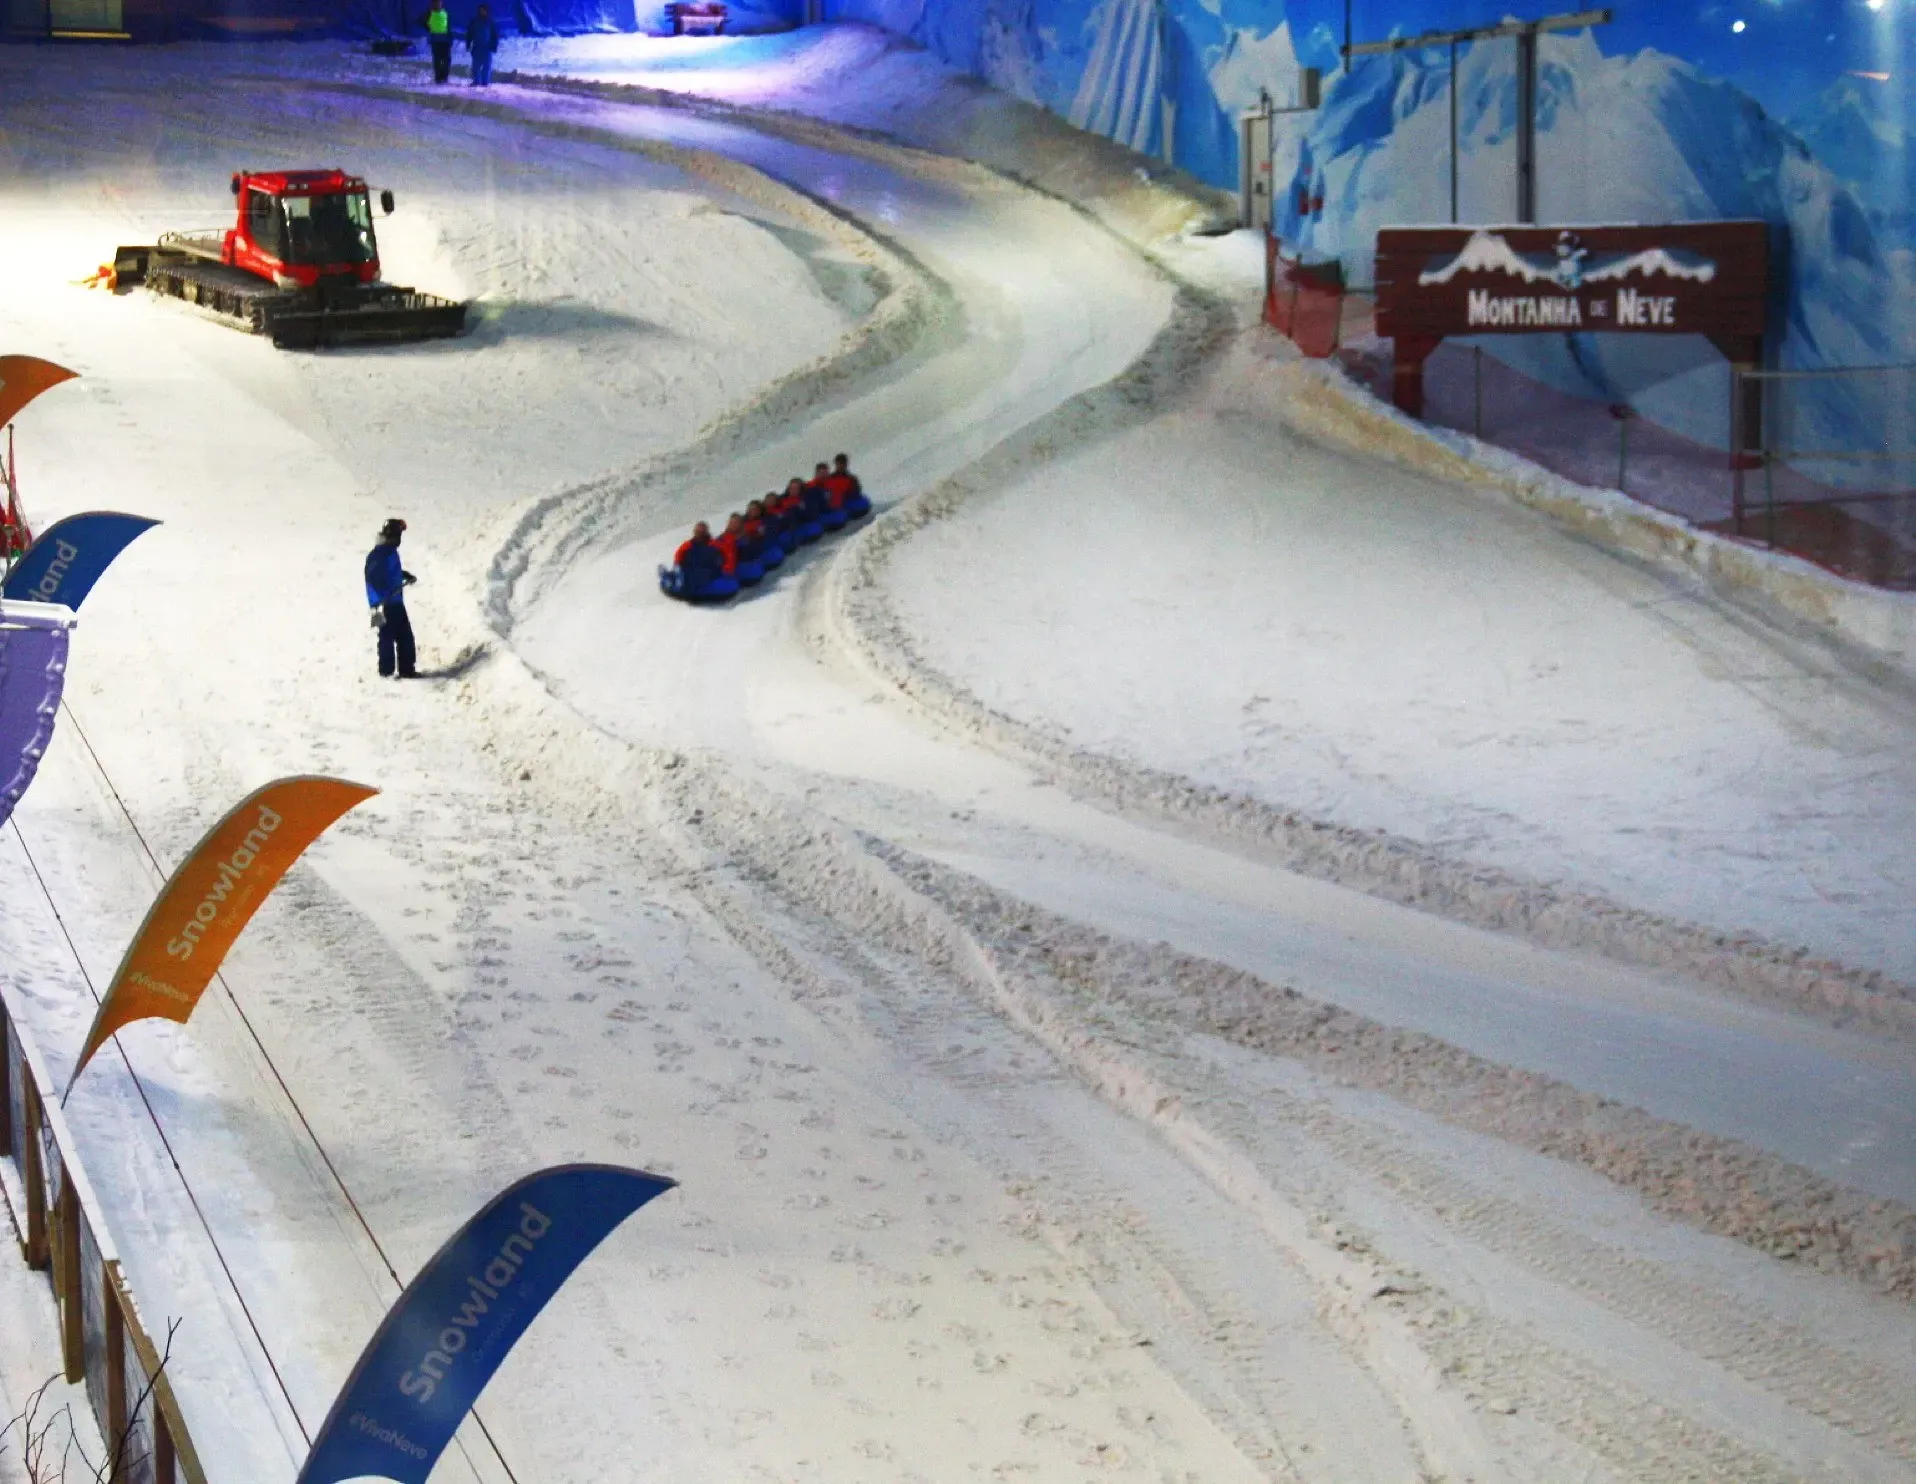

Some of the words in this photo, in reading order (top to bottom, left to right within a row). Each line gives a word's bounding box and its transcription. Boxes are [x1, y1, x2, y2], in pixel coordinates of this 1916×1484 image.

[1468, 289, 1582, 326] MONTANHA
[1617, 288, 1676, 325] NEVE
[28, 538, 78, 602] land
[167, 804, 282, 961] Snowland
[398, 1202, 552, 1404] Snowland
